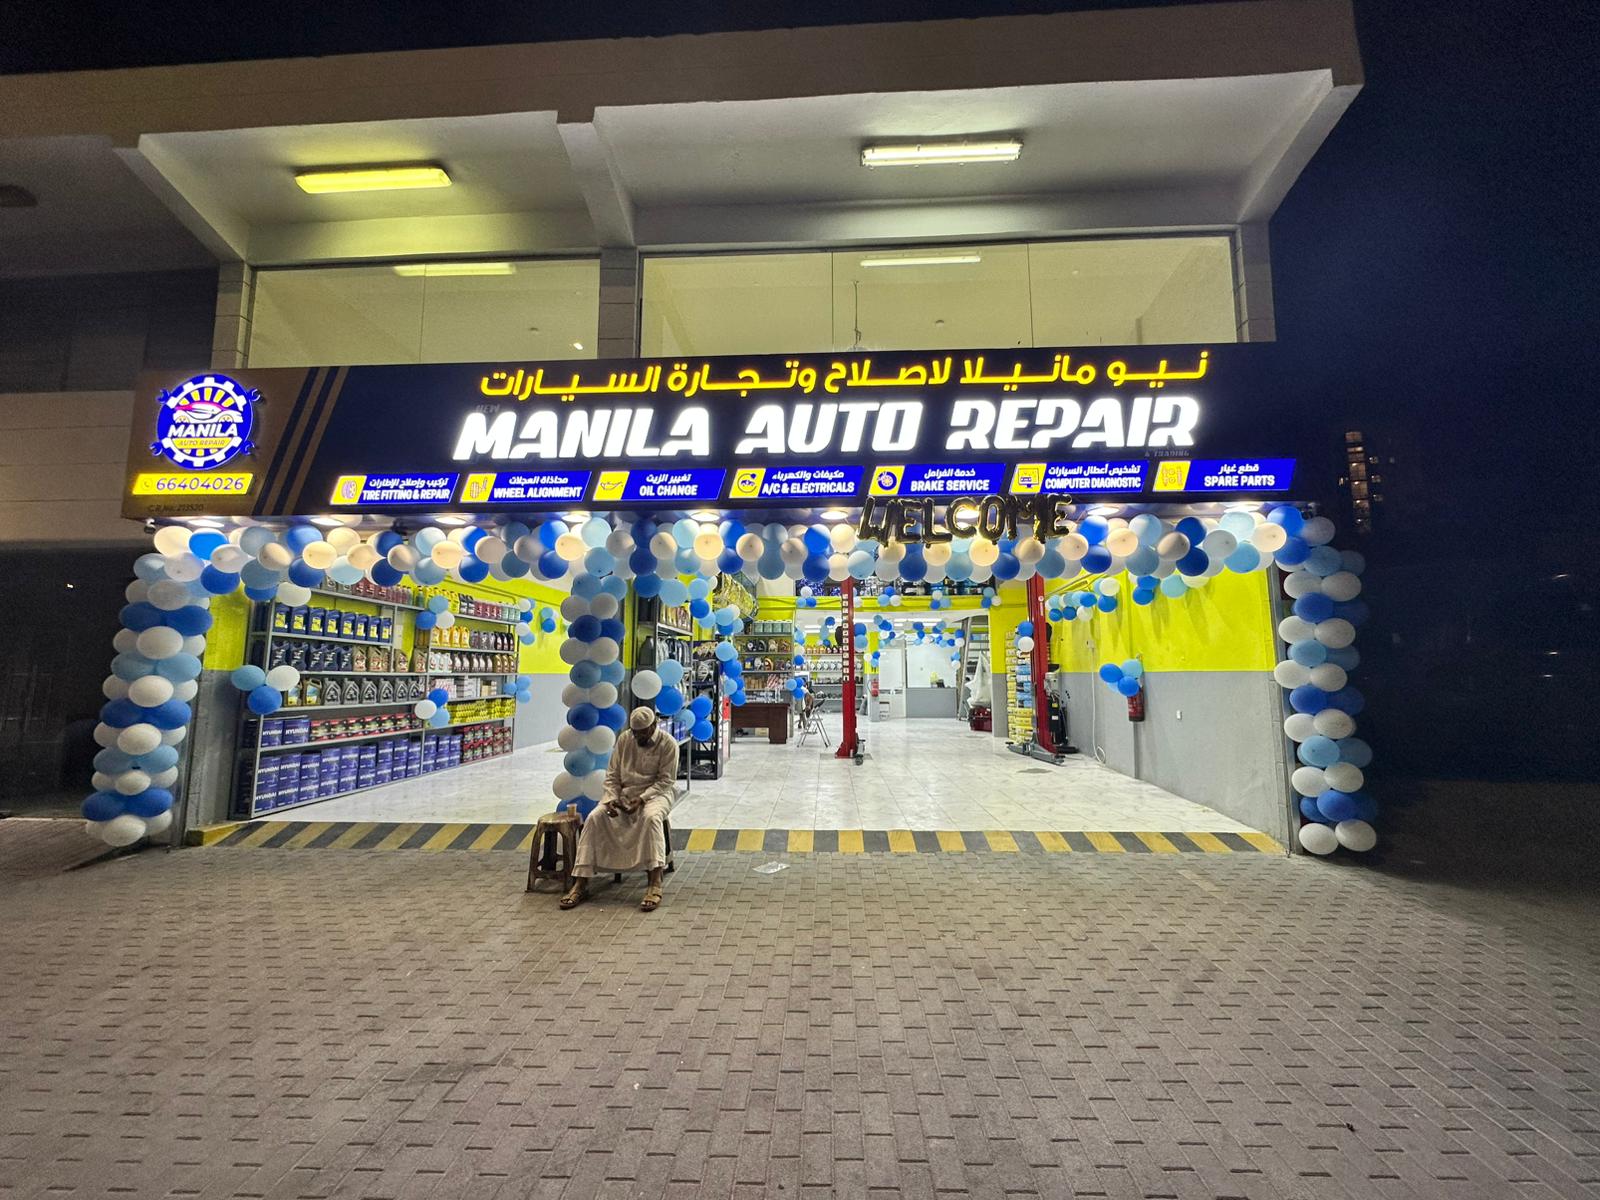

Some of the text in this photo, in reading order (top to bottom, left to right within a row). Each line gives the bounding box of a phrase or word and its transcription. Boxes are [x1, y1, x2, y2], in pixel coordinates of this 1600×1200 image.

[666, 360, 817, 398] وتجارة
[959, 355, 1096, 391] مانيلا
[479, 365, 663, 402] السيارات
[167, 423, 238, 437] MANILA
[452, 396, 1200, 461] MANILA AUTO REPAIR
[813, 470, 844, 480] مكيفات
[924, 468, 976, 480] خدمة الفرامل
[1048, 463, 1142, 477] تشخيص أعطال السيارات
[1218, 464, 1260, 474] قطع غيار
[156, 477, 244, 491] 66404026
[509, 476, 540, 486] العجلات
[646, 474, 692, 484] تغيير الزيت
[1045, 476, 1142, 490] COMPUTER DIAGNOSTIC
[1204, 475, 1275, 487] SPARE PARTS
[494, 486, 582, 499] WHEEL ALIGNMENT
[640, 484, 698, 496] OIL CHANGE
[762, 482, 855, 496] A/C & ELECTRICALS
[910, 480, 990, 492] BRAKE SERVICE
[362, 488, 450, 500] TIRE FITTING & REPAIR
[857, 493, 1072, 547] WELCOME
